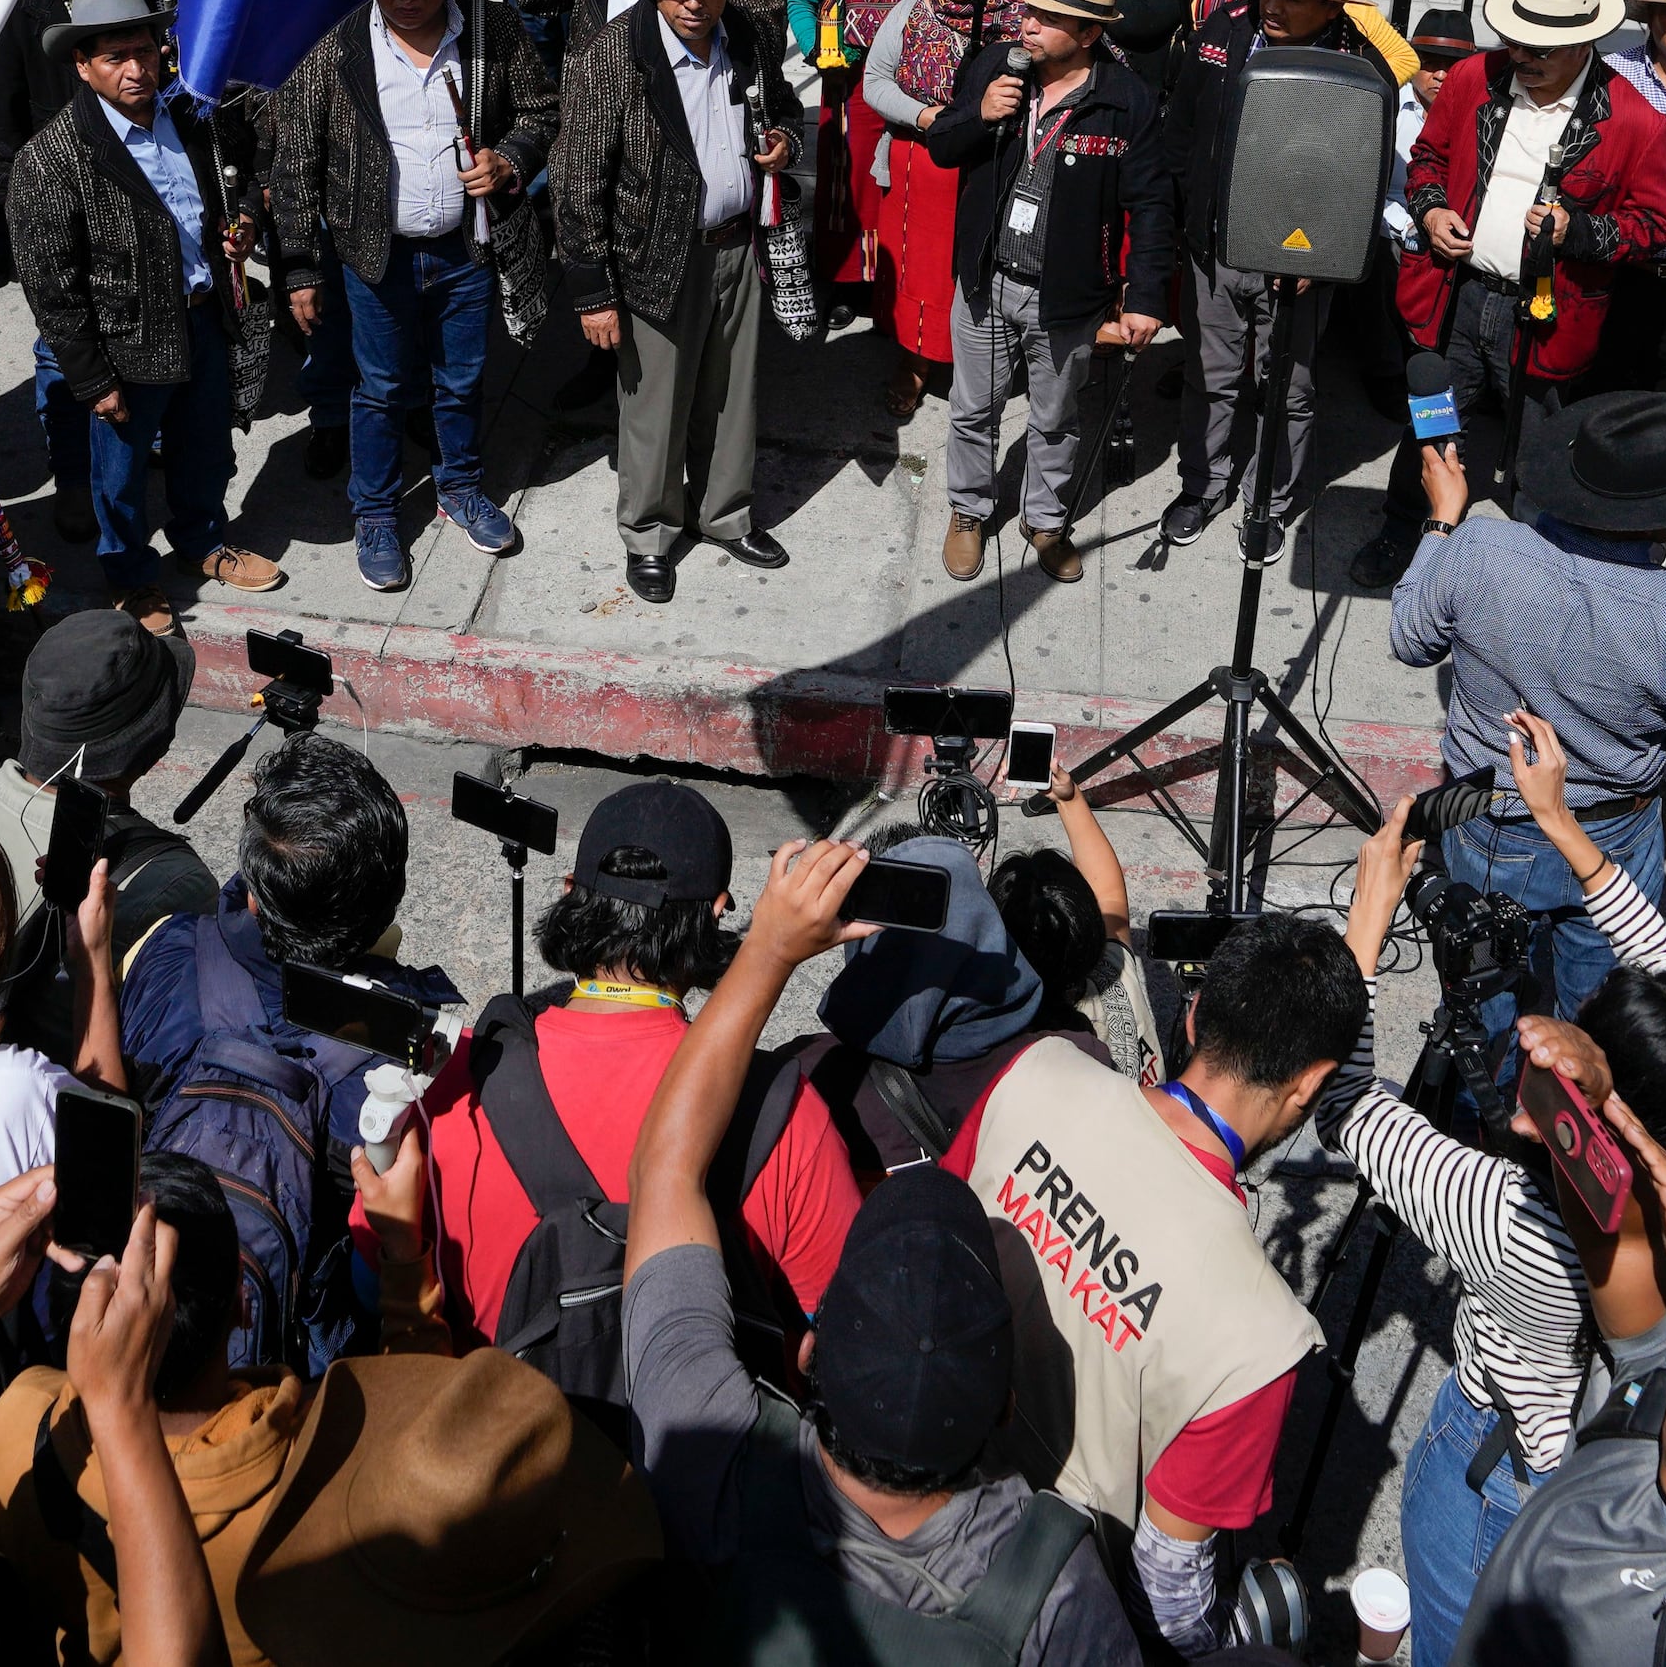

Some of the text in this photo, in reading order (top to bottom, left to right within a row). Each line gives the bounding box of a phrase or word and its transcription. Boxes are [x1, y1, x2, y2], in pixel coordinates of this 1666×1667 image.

[996, 1174, 1143, 1353] MAYA K'AT
[1014, 1140, 1163, 1333] PRENSA
